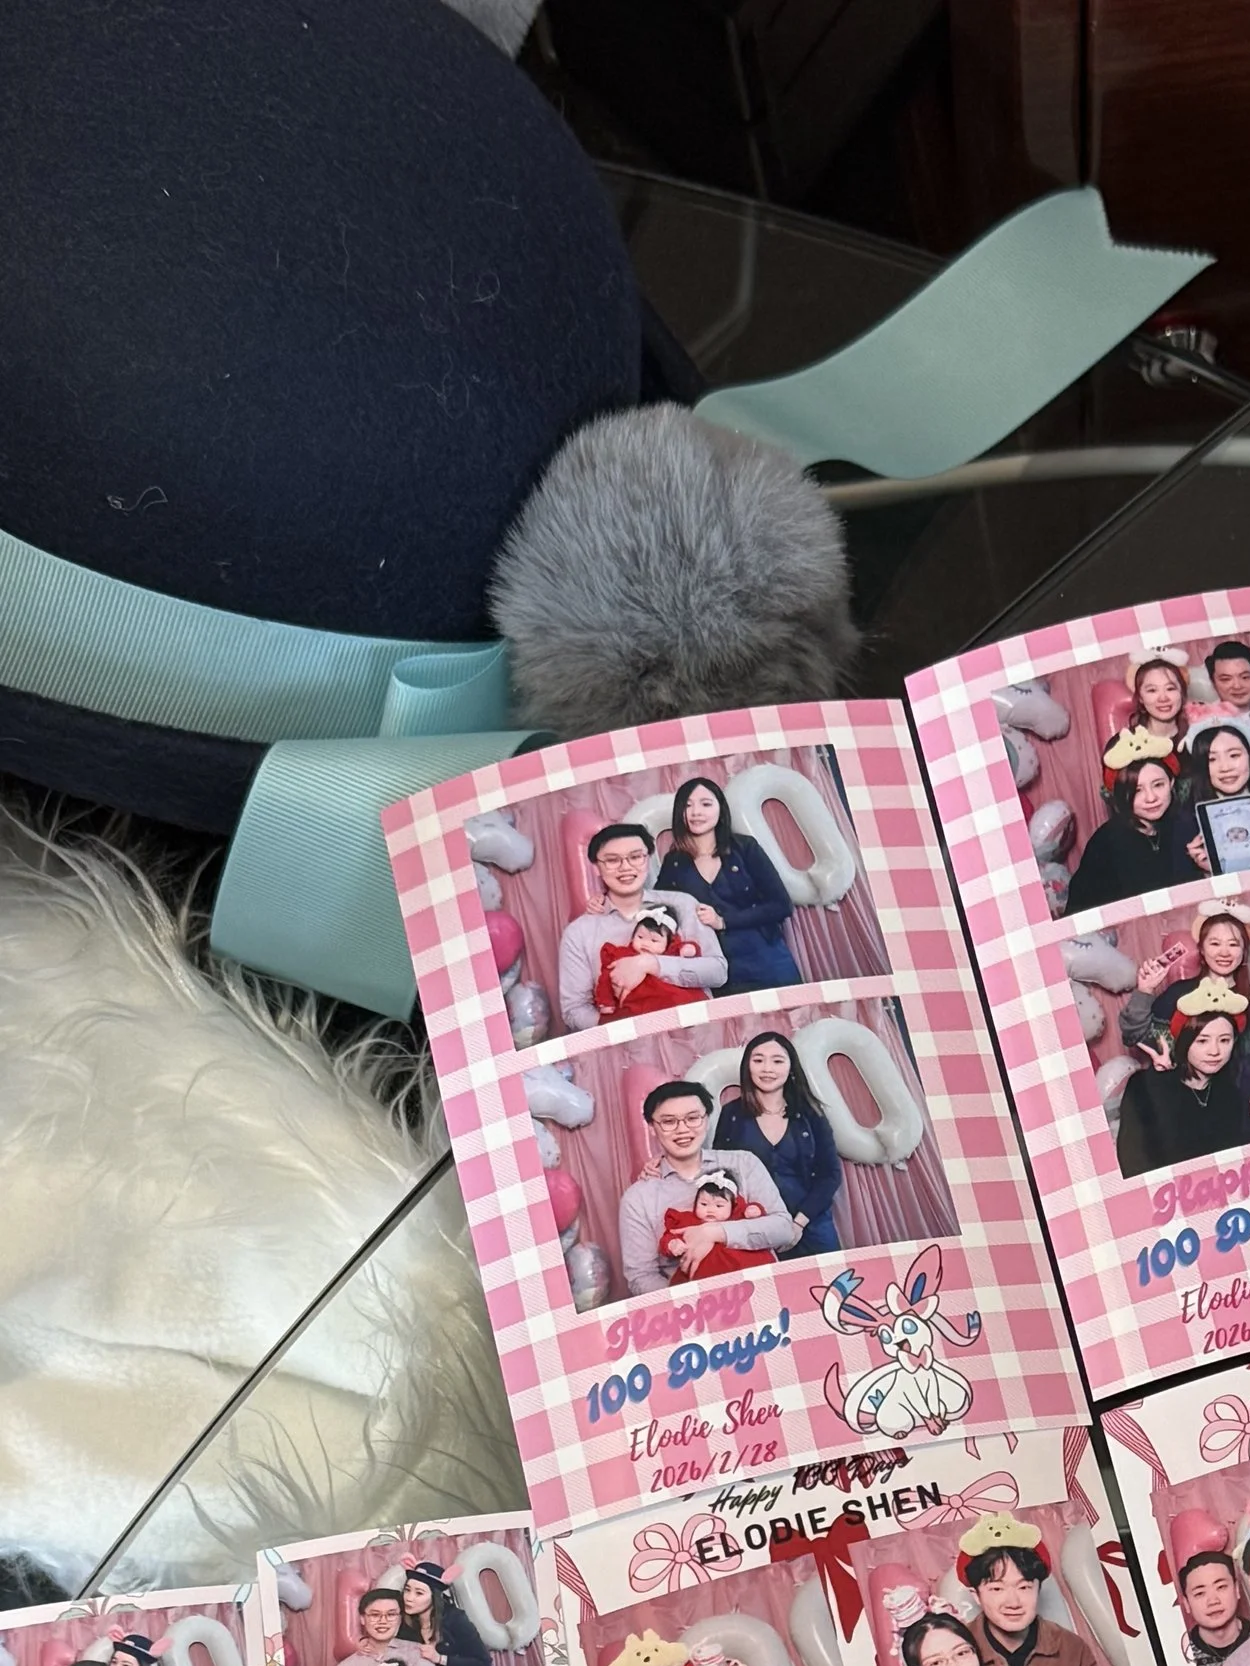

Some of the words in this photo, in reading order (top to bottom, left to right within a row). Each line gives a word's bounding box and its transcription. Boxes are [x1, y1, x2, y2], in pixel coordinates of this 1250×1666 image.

[1137, 1229, 1200, 1287] 100
[604, 1280, 756, 1362] Happy
[586, 1362, 653, 1424] 100
[667, 1308, 792, 1390] Days!
[629, 1419, 714, 1462] Elodie
[722, 1389, 783, 1437] Shen
[650, 1440, 778, 1494] 2026/2/28
[708, 1485, 783, 1518] Happy
[792, 1464, 841, 1495] 100
[848, 1454, 913, 1484] Days
[695, 1507, 831, 1565] ELODIE
[842, 1481, 942, 1525] SHEN
